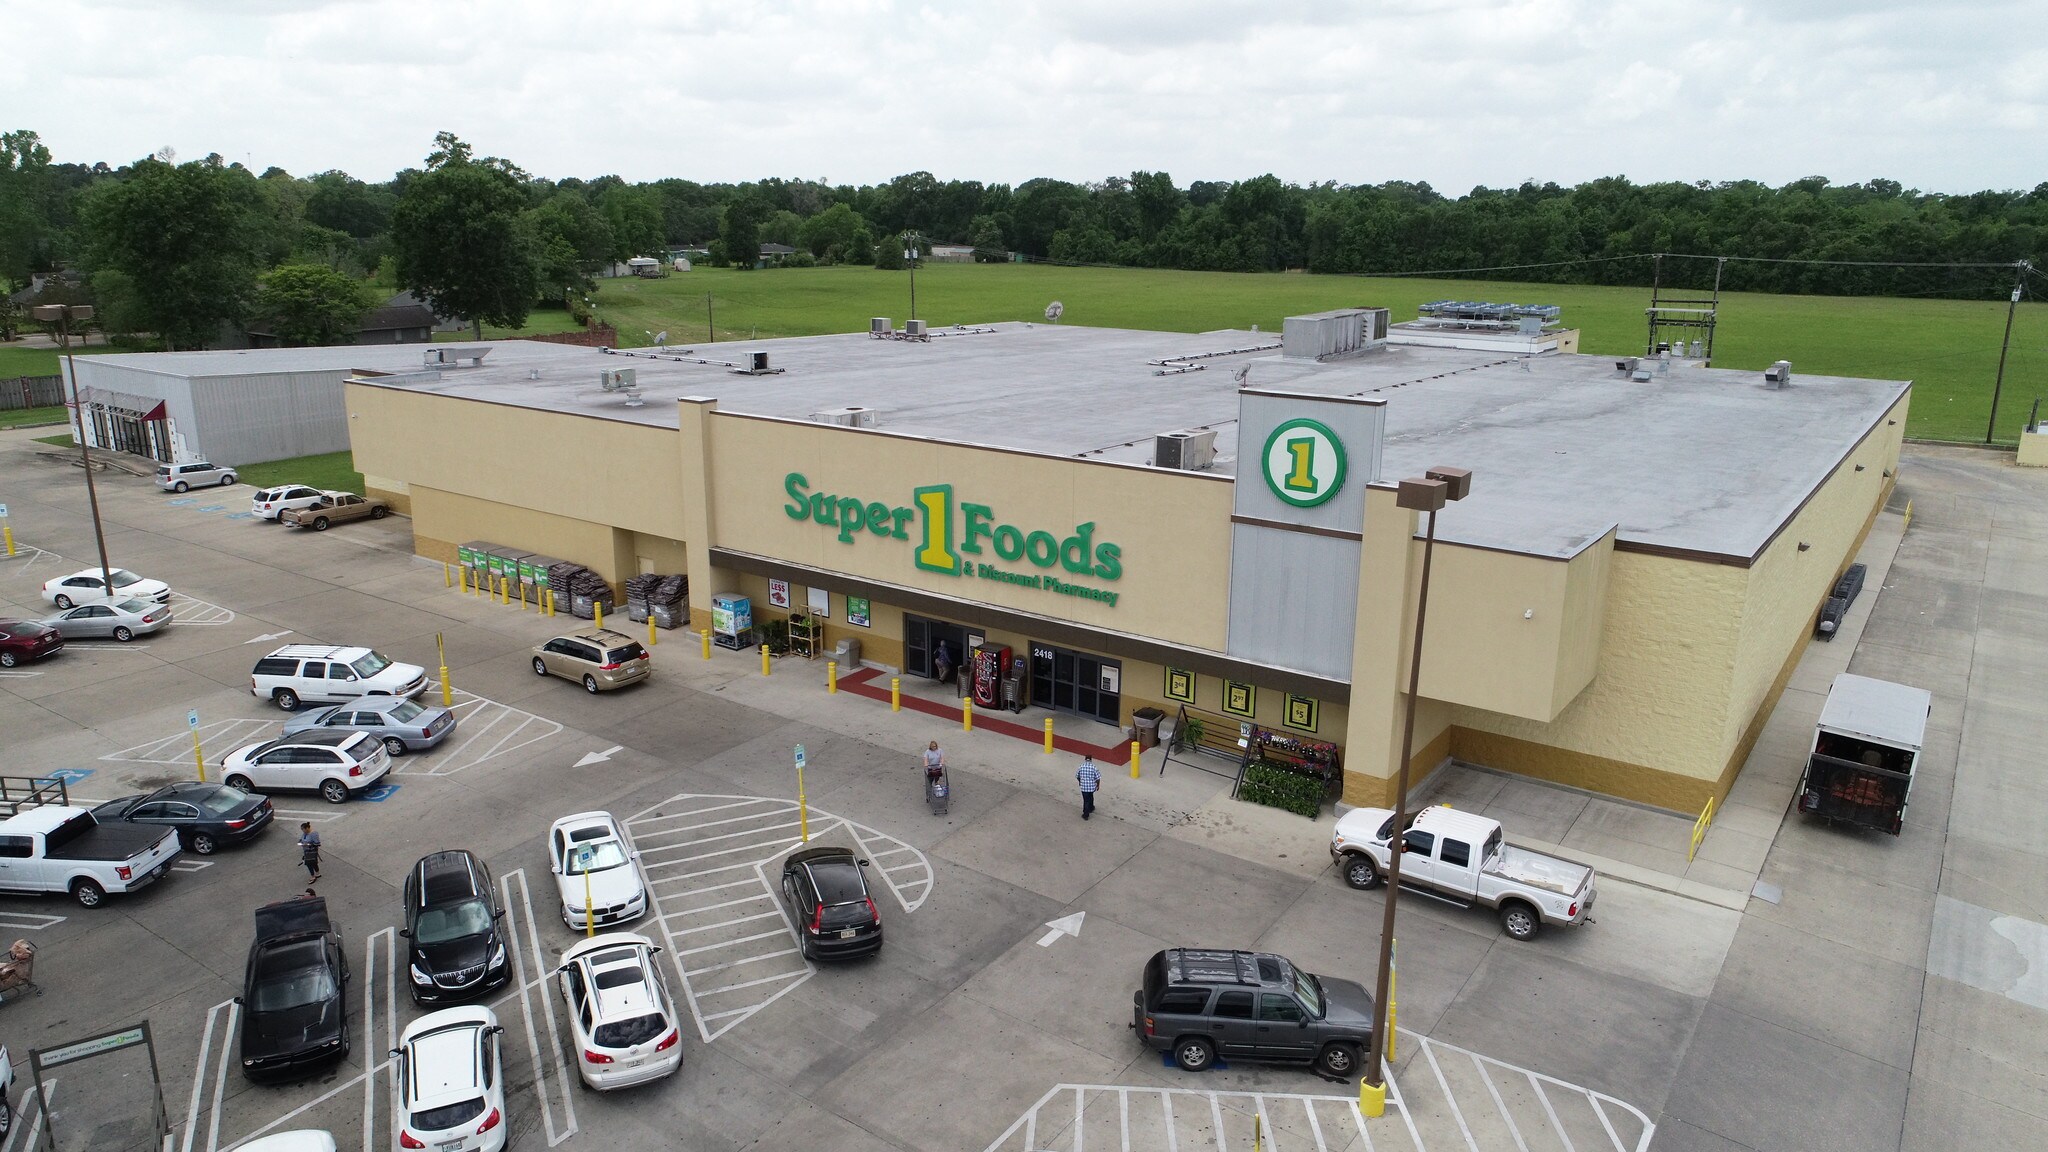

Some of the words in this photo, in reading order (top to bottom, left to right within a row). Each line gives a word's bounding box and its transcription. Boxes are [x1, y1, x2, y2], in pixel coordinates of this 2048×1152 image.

[1285, 437, 1318, 494] 1
[784, 472, 914, 545] Super
[913, 483, 962, 577] 1
[960, 502, 1123, 581] Foods
[963, 561, 975, 577] &
[977, 563, 1042, 590] Discount
[1043, 576, 1120, 608] Pharmacy
[1034, 648, 1053, 660] 2418
